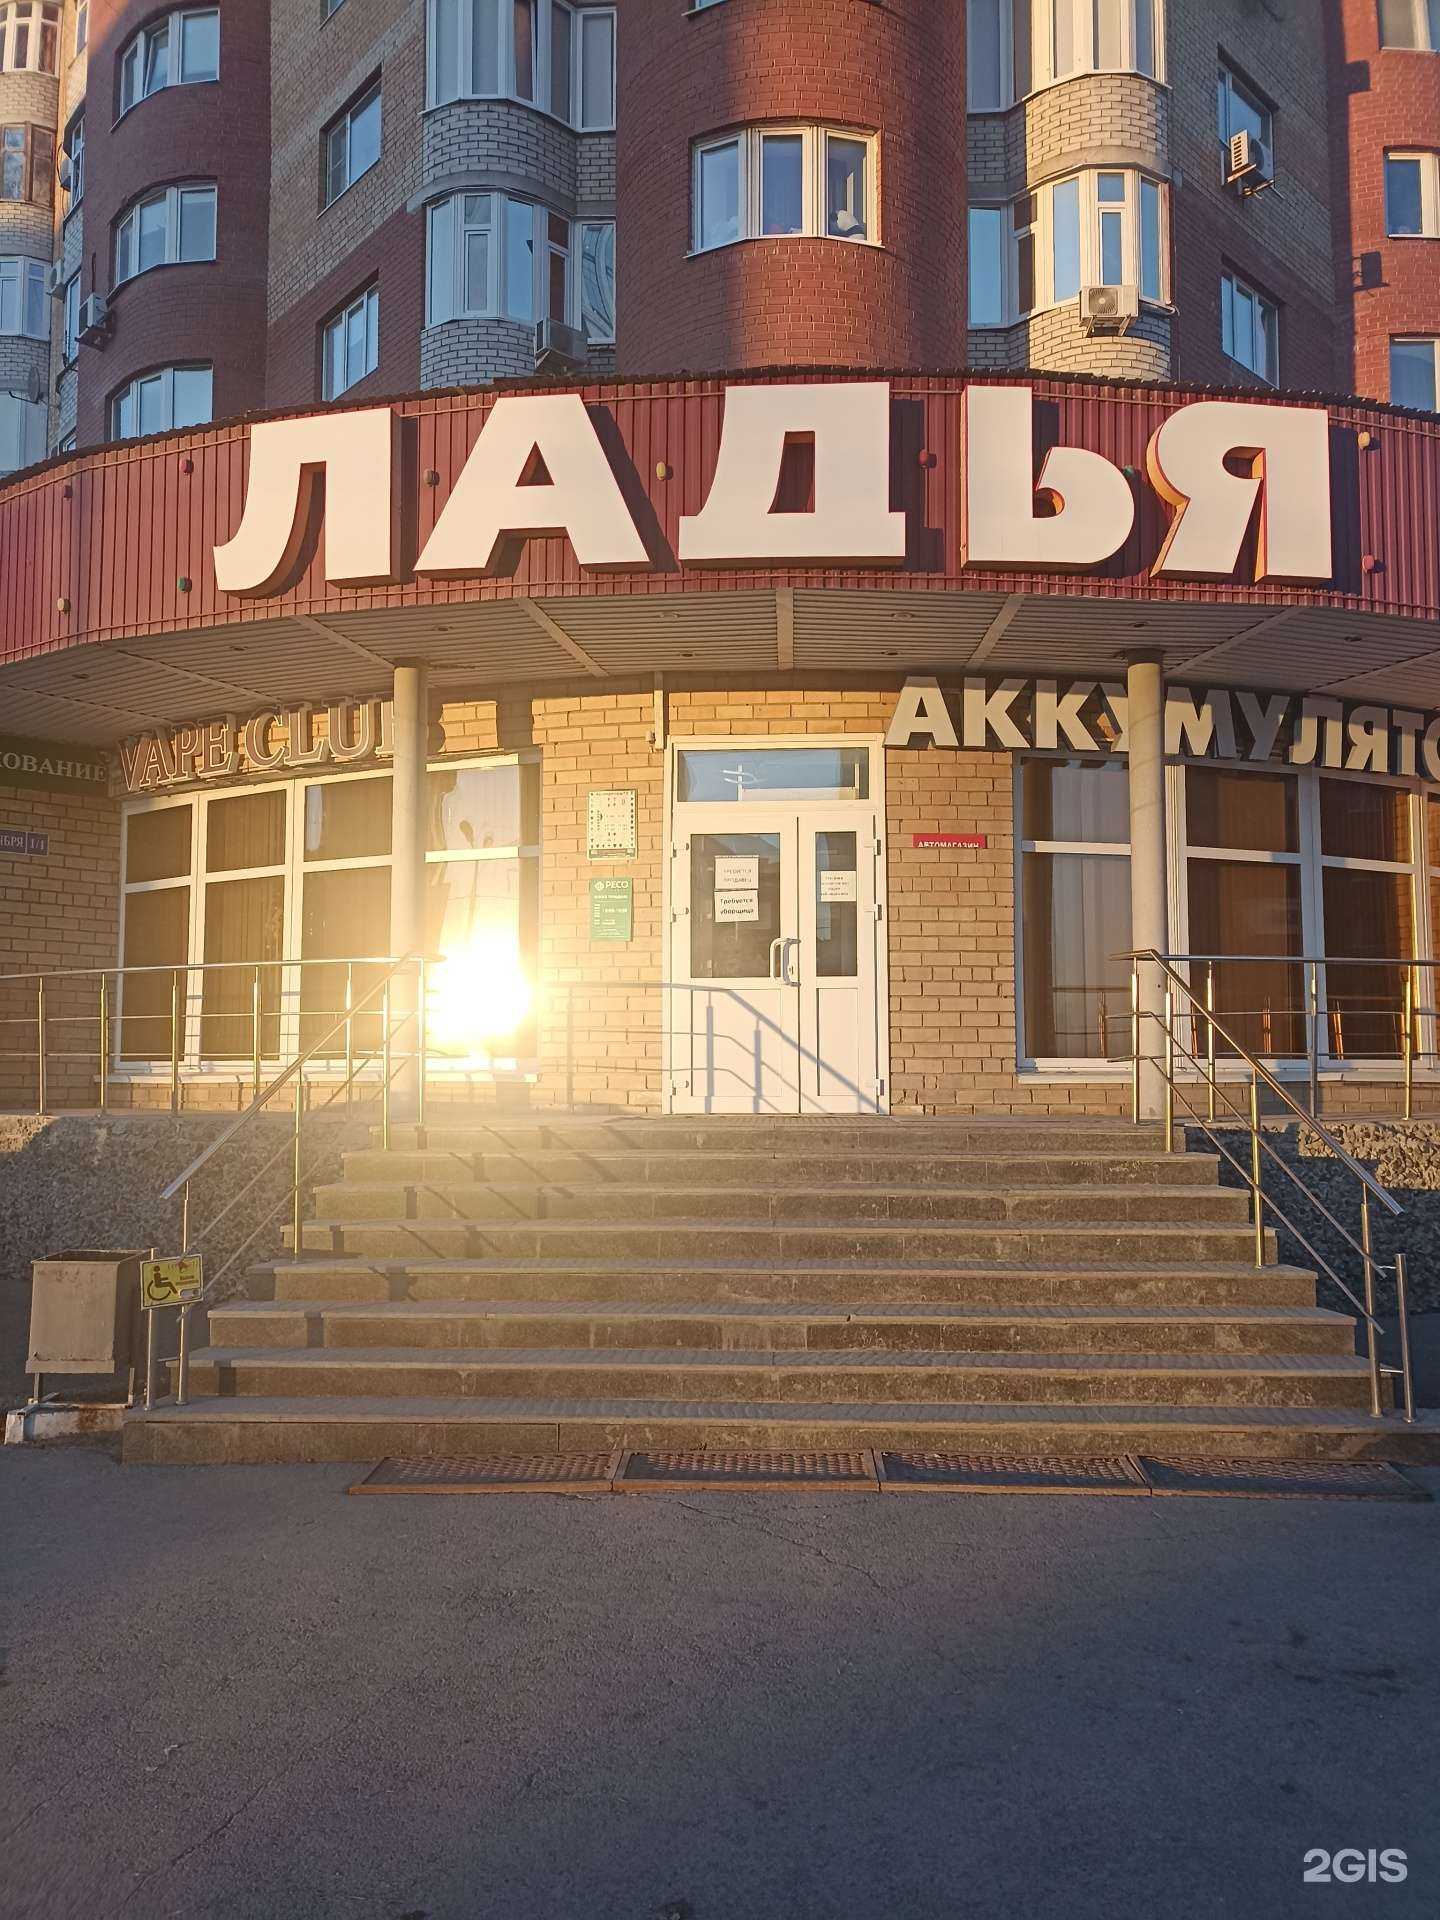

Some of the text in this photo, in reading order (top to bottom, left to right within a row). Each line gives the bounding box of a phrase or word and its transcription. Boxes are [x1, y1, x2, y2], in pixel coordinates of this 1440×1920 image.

[213, 381, 1334, 592] ЛАДЬЯ
[0, 751, 107, 782] ОВАНИЕ
[117, 713, 238, 793] VAPE
